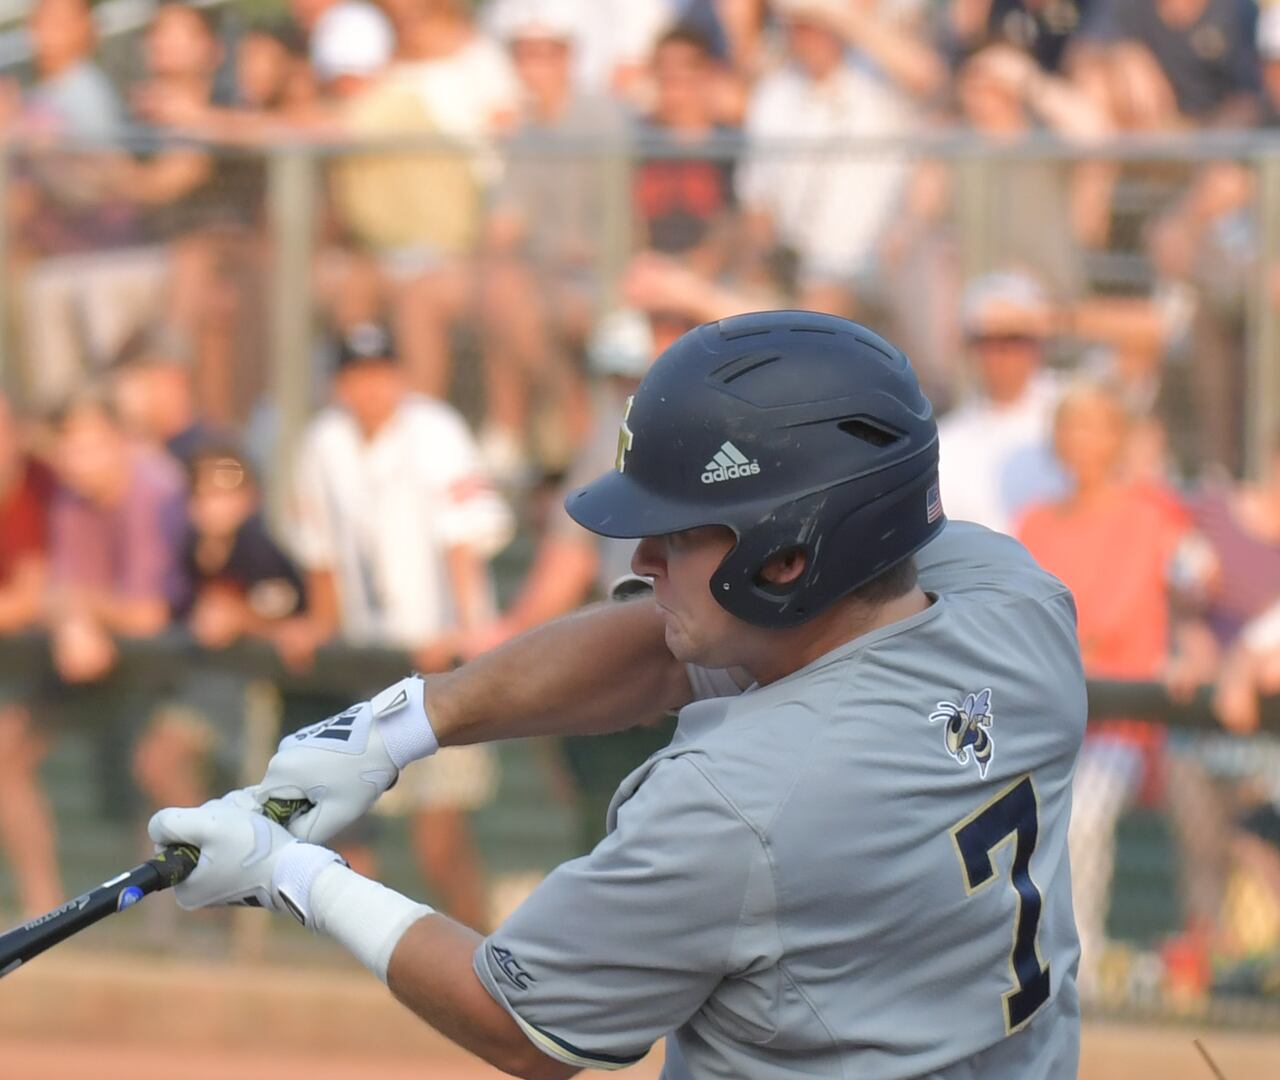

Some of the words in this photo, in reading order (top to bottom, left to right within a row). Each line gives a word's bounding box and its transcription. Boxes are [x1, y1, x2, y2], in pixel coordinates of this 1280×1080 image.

[701, 461, 761, 484] adidas
[949, 774, 1051, 1036] 7
[491, 946, 538, 990] ACC
